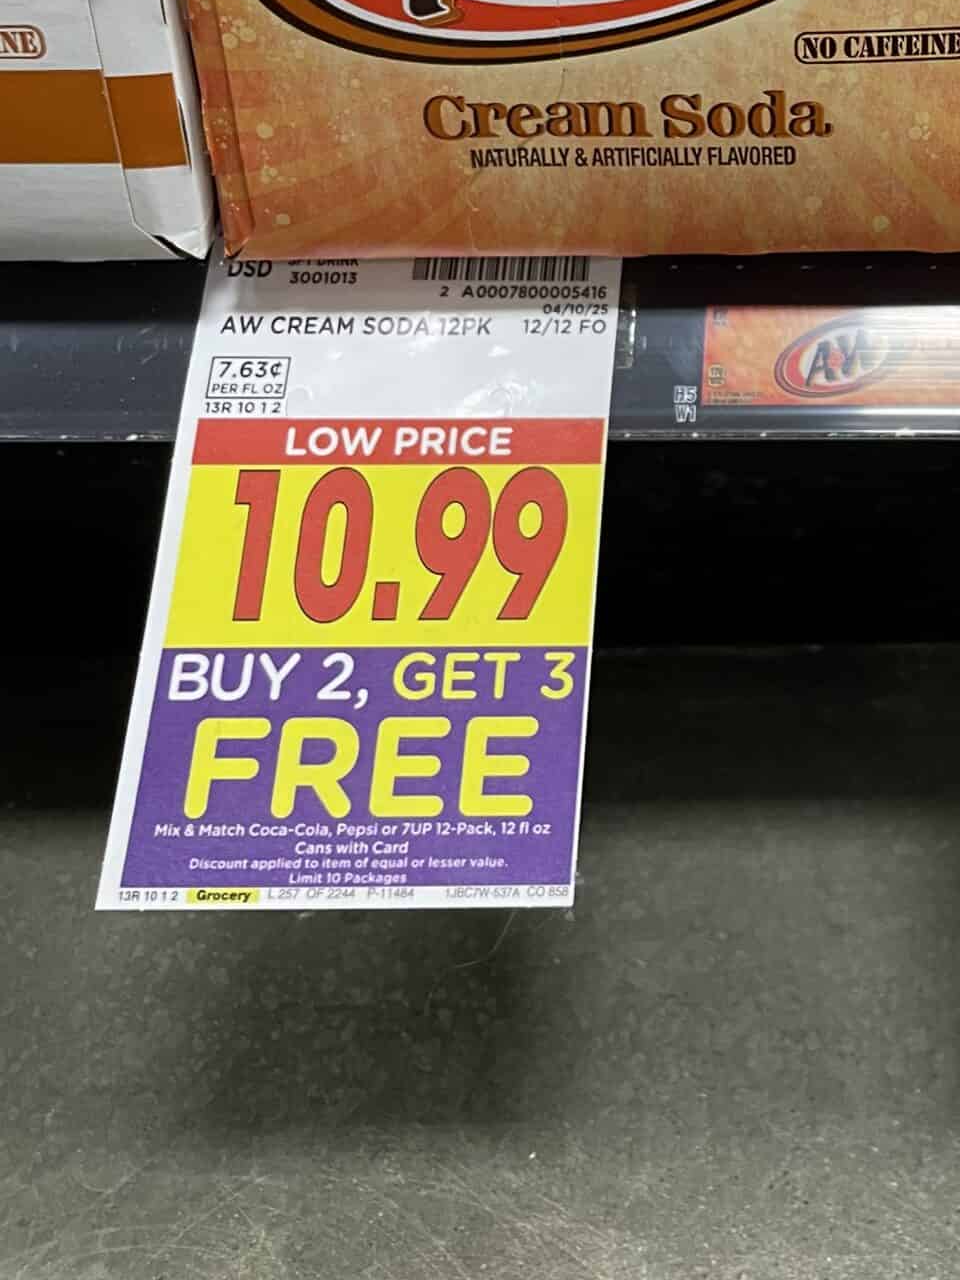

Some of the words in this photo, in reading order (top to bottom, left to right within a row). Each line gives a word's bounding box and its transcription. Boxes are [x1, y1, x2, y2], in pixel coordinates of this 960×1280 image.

[802, 36, 837, 59] NO
[424, 94, 652, 140] Cream
[661, 91, 833, 140] Soda
[470, 147, 569, 168] NATURALLY
[574, 148, 588, 168] &
[592, 147, 702, 168] ARTIFICIALLY
[707, 147, 797, 168] FLAVORED
[227, 259, 272, 278] DSD
[289, 271, 358, 284] 3001013
[439, 286, 449, 297] 2
[543, 303, 608, 315] 04/10/25
[220, 315, 264, 335] AW
[271, 315, 353, 335] CREAM
[362, 317, 429, 335] SODA
[440, 317, 492, 336] 12PK
[524, 318, 571, 336] 12/12
[579, 319, 607, 335] FO
[219, 361, 283, 379] 7.63¢
[211, 383, 238, 395] PER
[242, 383, 258, 395] FL
[263, 383, 284, 395] OZ
[205, 401, 232, 414] 13R
[238, 401, 256, 414] 10
[271, 402, 282, 414] 2
[285, 426, 382, 456] LOW
[393, 426, 513, 456] PRICE
[232, 466, 569, 624] 10.99
[167, 652, 300, 702] BUY
[316, 652, 369, 709] 2,
[392, 652, 521, 701] GET
[540, 651, 576, 701] 3
[183, 715, 540, 819] FREE
[154, 823, 180, 837] Mix
[184, 824, 195, 837] &
[198, 823, 245, 837] Match
[249, 823, 332, 839] Coca-Cola,
[336, 822, 378, 839] Pepsi
[381, 824, 397, 836] or
[401, 822, 432, 836] 7UP
[436, 821, 497, 837] 12-Pack,
[501, 822, 515, 835] 12
[519, 821, 529, 835] fl
[533, 824, 551, 835] oz
[294, 841, 332, 854] Cans
[336, 840, 368, 854] with
[372, 841, 409, 854] Card
[189, 858, 247, 870] Discount
[250, 857, 301, 872] applied
[304, 858, 319, 869] to
[322, 857, 351, 869] item
[354, 856, 369, 868] of
[371, 856, 408, 870] equal
[411, 858, 425, 868] or
[428, 857, 466, 868] lesser
[470, 857, 508, 868] value.
[288, 872, 322, 884] Limit
[326, 872, 341, 884] 10
[344, 872, 408, 886] Packages
[196, 889, 252, 903] Grocery
